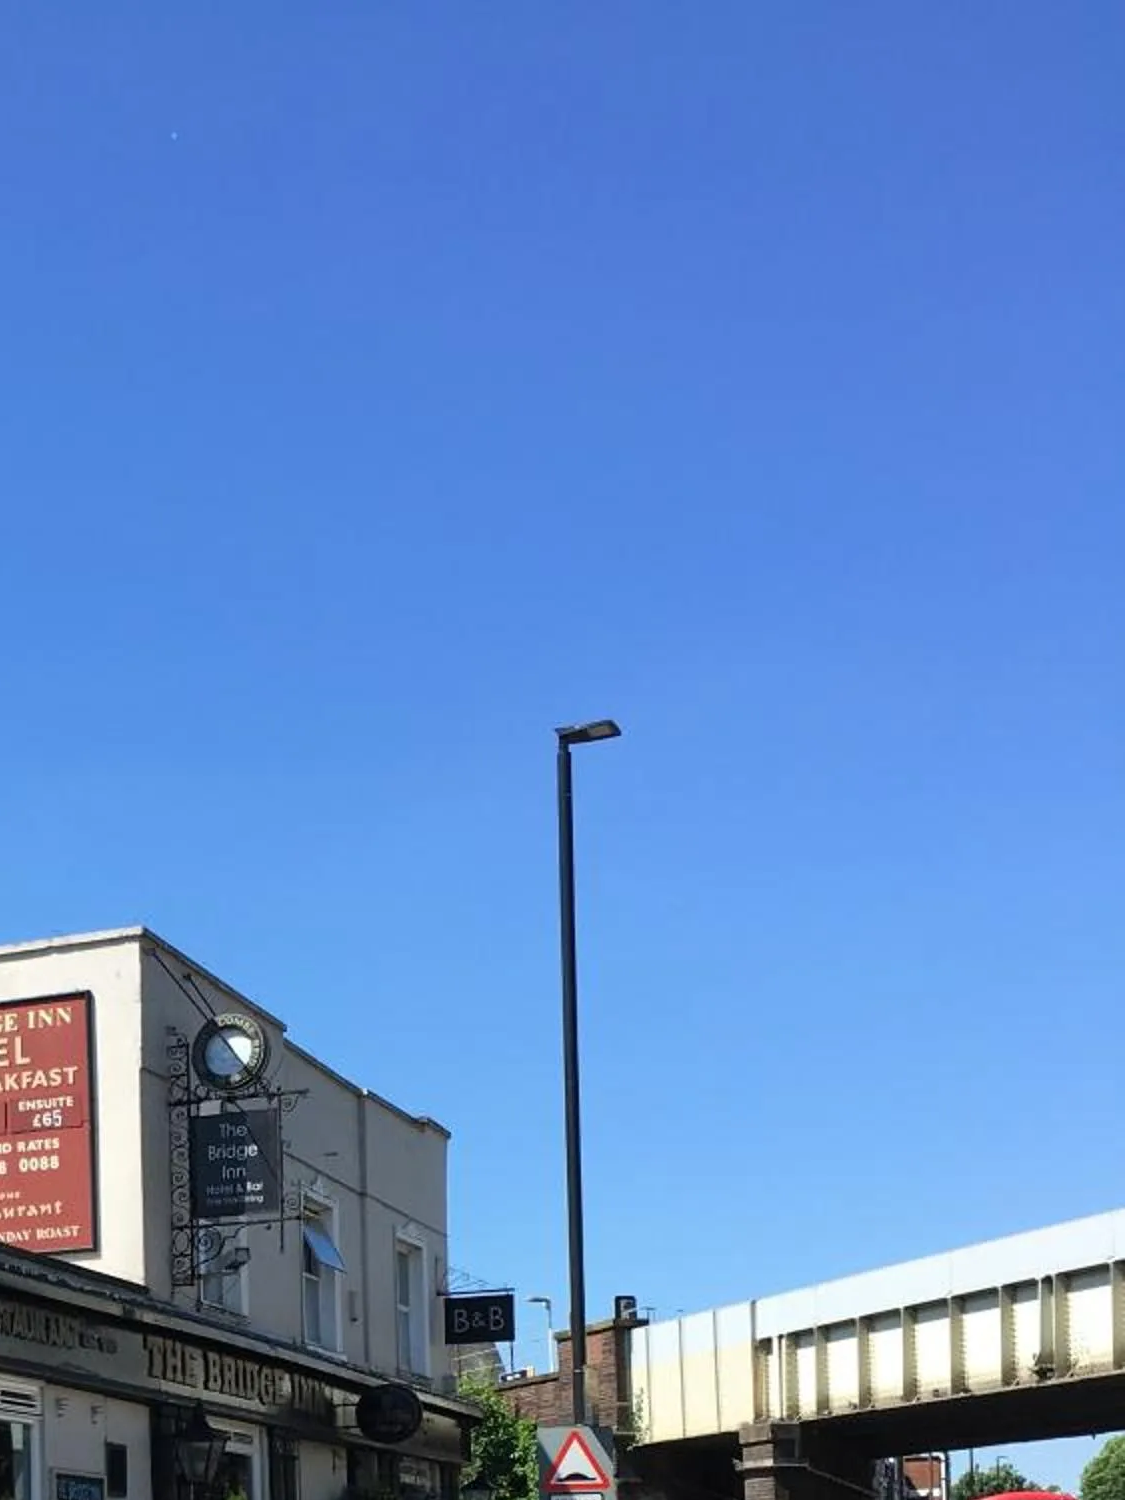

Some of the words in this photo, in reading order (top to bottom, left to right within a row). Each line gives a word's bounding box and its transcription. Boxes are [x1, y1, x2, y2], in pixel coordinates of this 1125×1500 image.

[27, 1007, 73, 1029] INN
[18, 1096, 74, 1112] ENSUITE
[32, 1110, 62, 1128] £65
[219, 1124, 249, 1139] The
[17, 1137, 60, 1153] RATES
[208, 1144, 258, 1162] Bridge
[19, 1155, 60, 1172] 0088
[222, 1166, 246, 1180] Inn
[36, 1225, 81, 1240] ROAST
[454, 1307, 504, 1333] B&B
[146, 1335, 204, 1387] THE
[208, 1352, 291, 1405] BRIDGE
